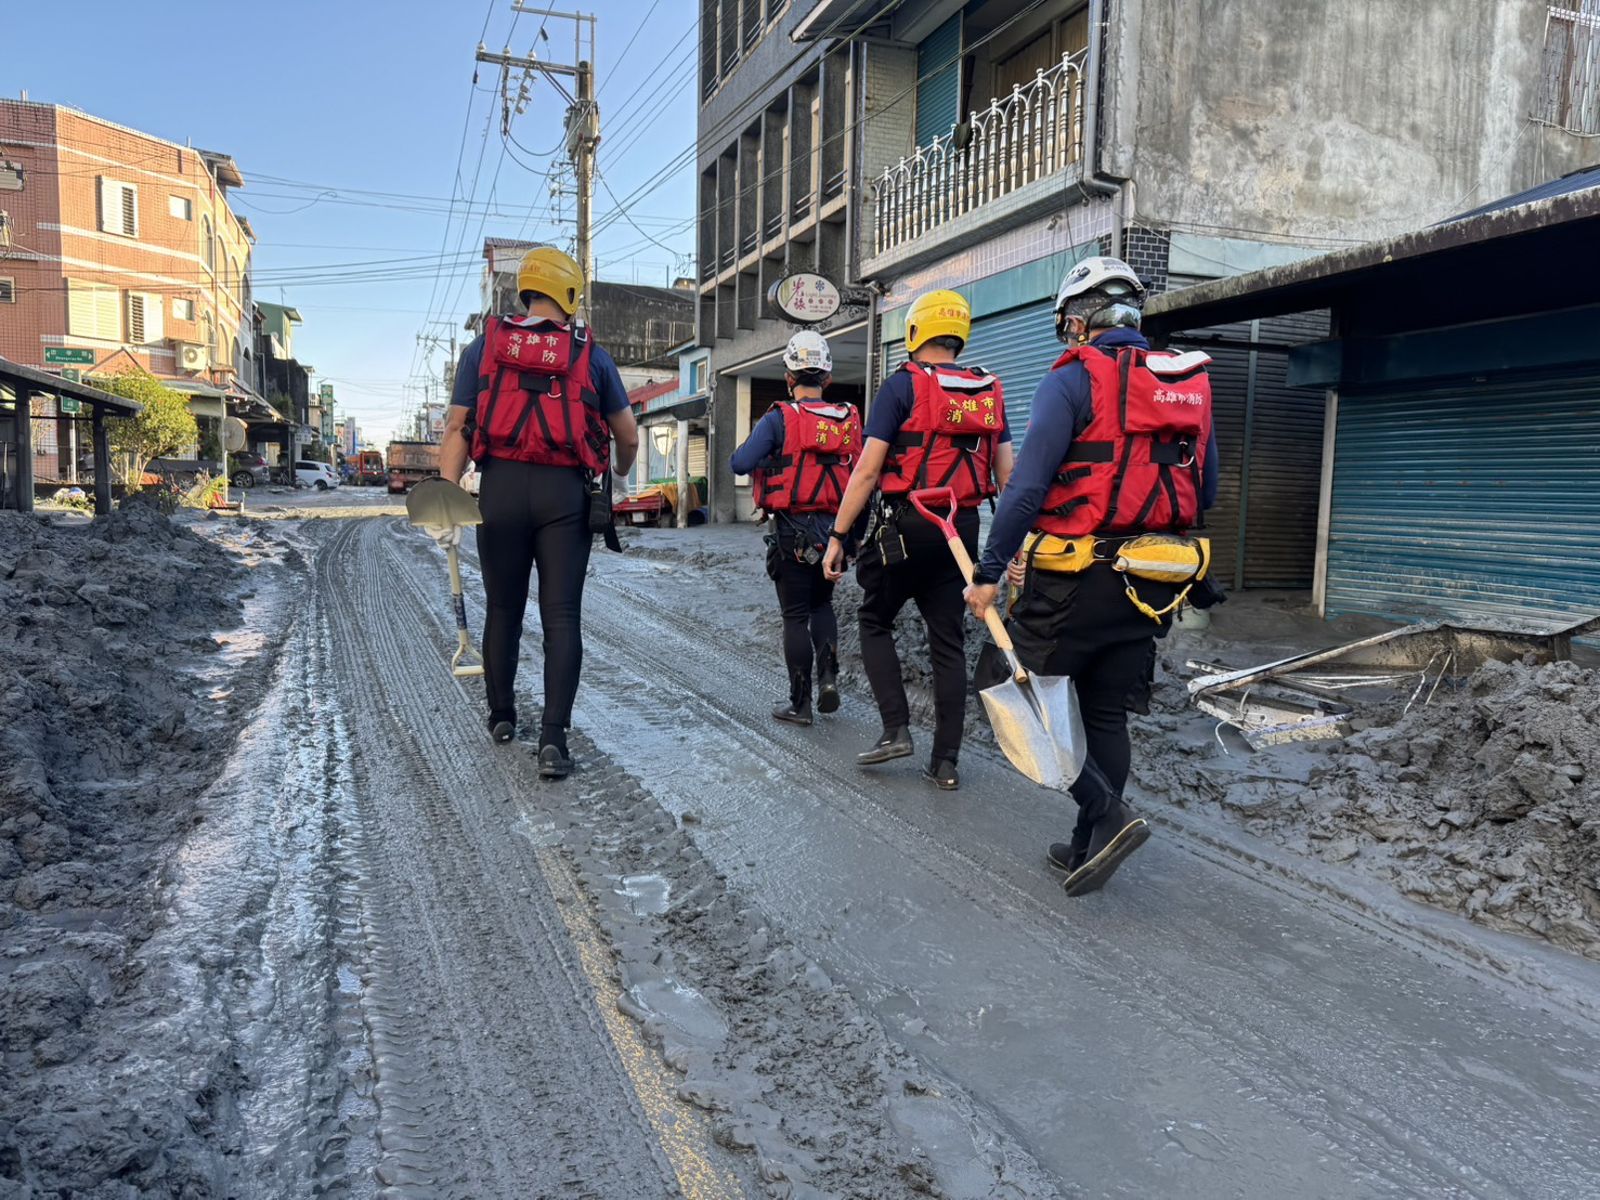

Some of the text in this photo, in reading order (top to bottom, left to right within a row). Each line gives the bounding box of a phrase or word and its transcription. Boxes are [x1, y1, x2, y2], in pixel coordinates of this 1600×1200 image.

[509, 332, 559, 348] 高雄市
[507, 343, 558, 364] 消防
[1153, 388, 1204, 406] 高雄市消防
